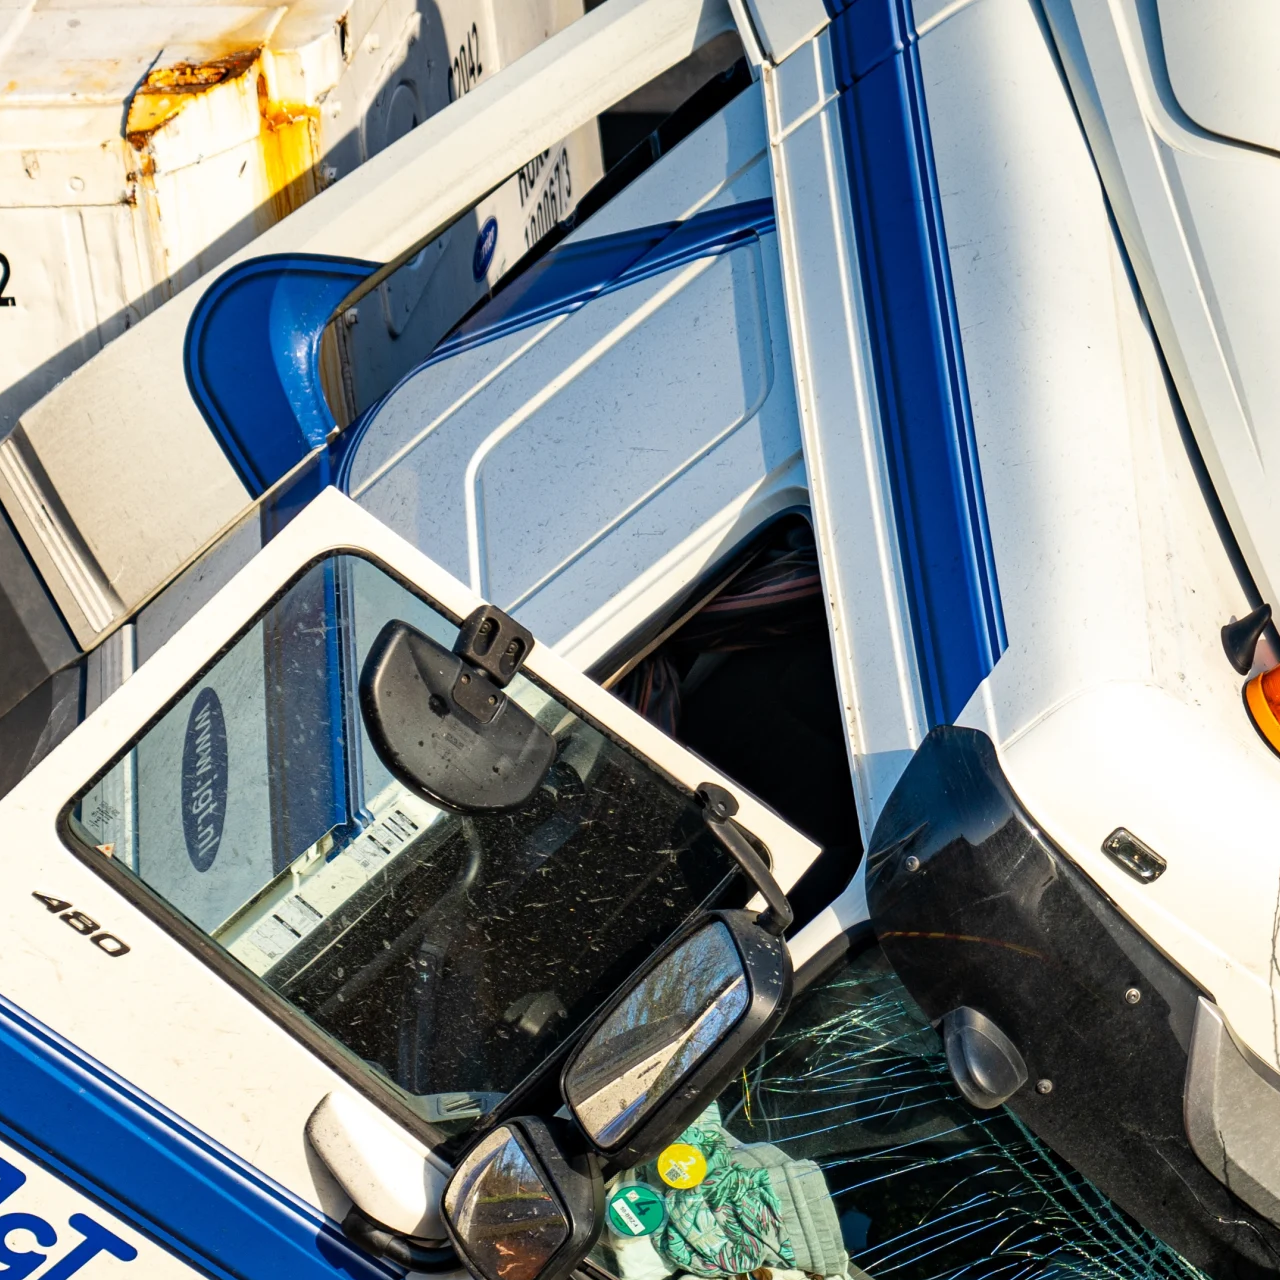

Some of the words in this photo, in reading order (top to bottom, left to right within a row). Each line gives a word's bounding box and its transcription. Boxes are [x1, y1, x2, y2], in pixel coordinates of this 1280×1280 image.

[191, 702, 220, 858] www.jgt.nl
[31, 891, 131, 957] 480
[634, 1200, 658, 1216] 4
